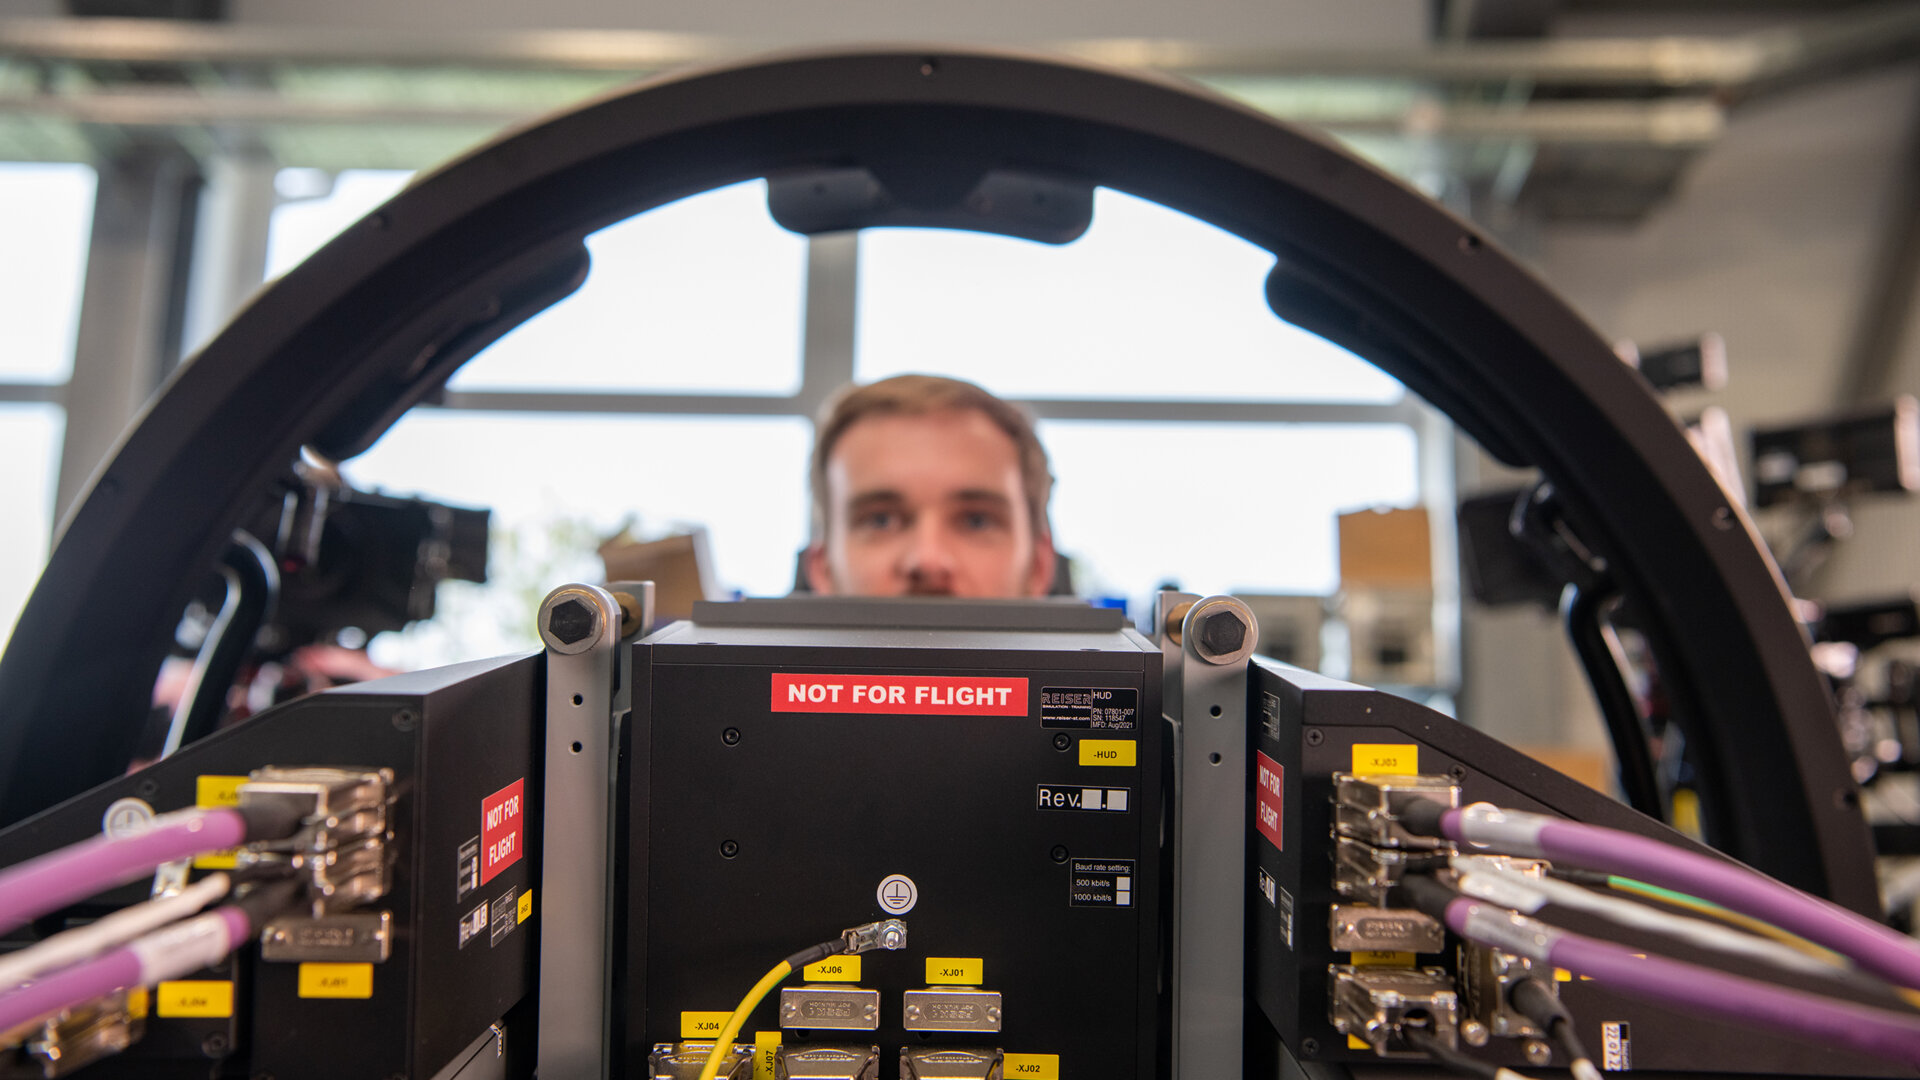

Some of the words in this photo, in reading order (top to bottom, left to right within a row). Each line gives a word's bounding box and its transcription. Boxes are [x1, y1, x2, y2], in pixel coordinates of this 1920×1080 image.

[787, 683, 844, 703] NOT
[852, 684, 906, 704] FOR
[914, 686, 1013, 706] FLIGHT
[1042, 692, 1092, 705] REISER
[1093, 691, 1112, 700] HUD
[1104, 708, 1135, 716] 07801-007
[1108, 722, 1133, 731] Aug/2021
[1093, 751, 1118, 759] -HUD
[1259, 764, 1270, 789] NOT
[1269, 771, 1281, 798] FOR
[486, 804, 504, 832] NOT
[504, 794, 519, 821] FOR
[1260, 800, 1278, 833] FLIGHT
[488, 831, 517, 868] FLIGHT
[1075, 863, 1093, 871] Baud
[1107, 864, 1131, 873] setting:
[1076, 878, 1090, 887] 500
[1091, 879, 1111, 887] kbit/s
[1074, 893, 1092, 901] 1000
[1092, 893, 1112, 902] kbit/s
[817, 965, 843, 974] -XJ06
[939, 968, 964, 977] -XJ01
[694, 1022, 720, 1031] -XJ04
[765, 1050, 774, 1076] -XJ07
[1015, 1064, 1041, 1073] -XJ02
